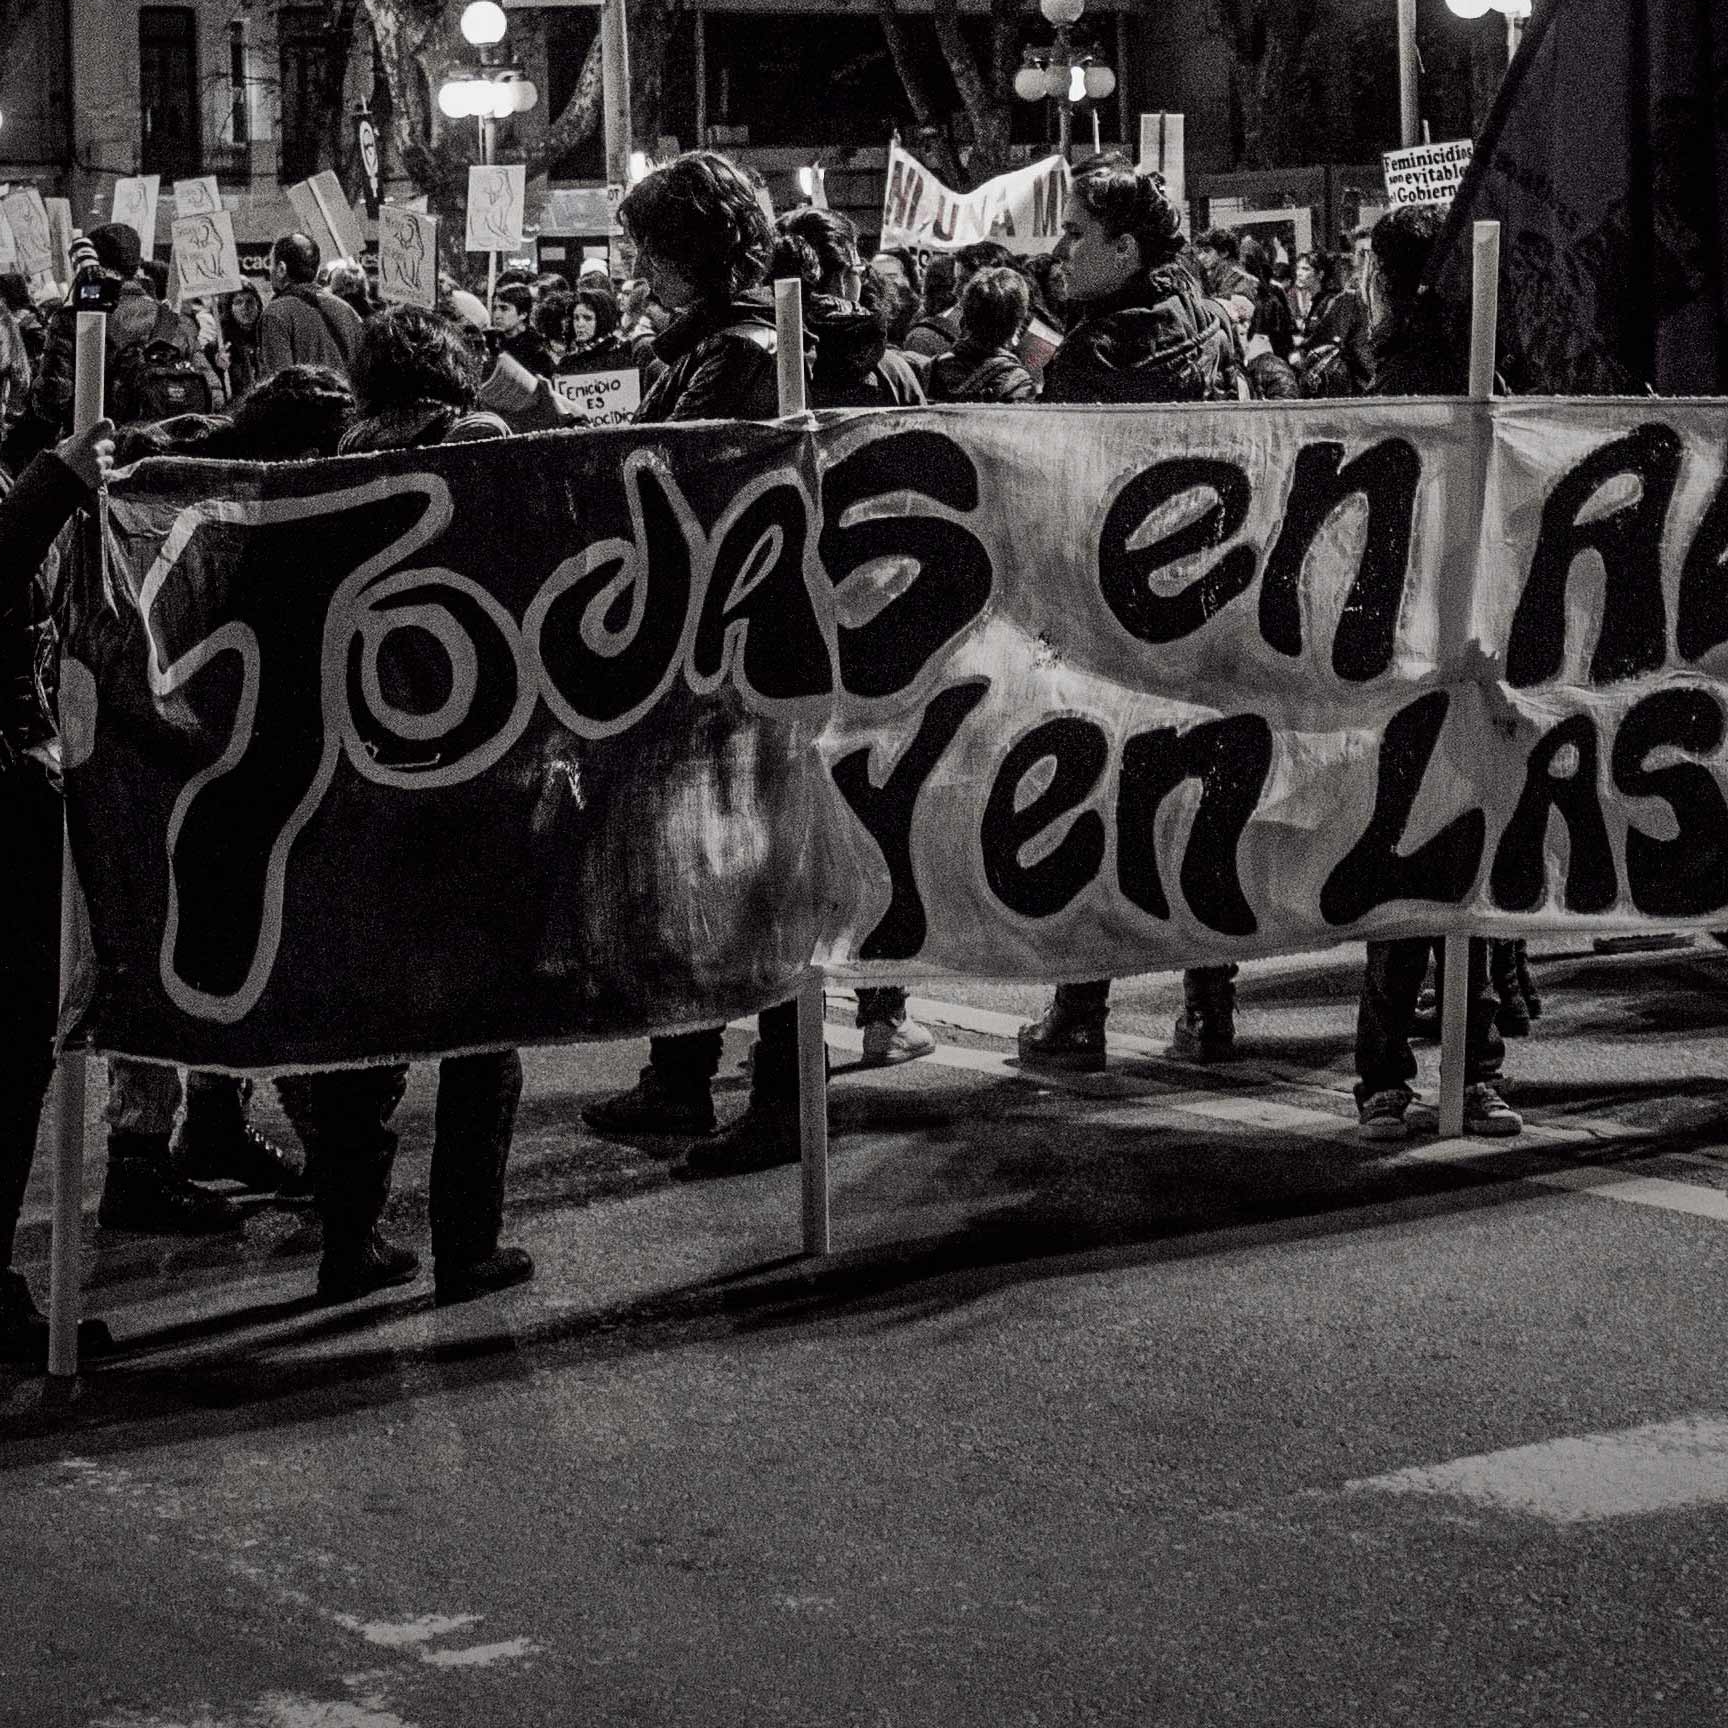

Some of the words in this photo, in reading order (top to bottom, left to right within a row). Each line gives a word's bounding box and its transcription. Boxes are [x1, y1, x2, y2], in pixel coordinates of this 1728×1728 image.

[1383, 145, 1472, 172] Feminicidios
[1389, 174, 1404, 184] son
[587, 397, 605, 409] ES
[1098, 436, 1421, 682] en
